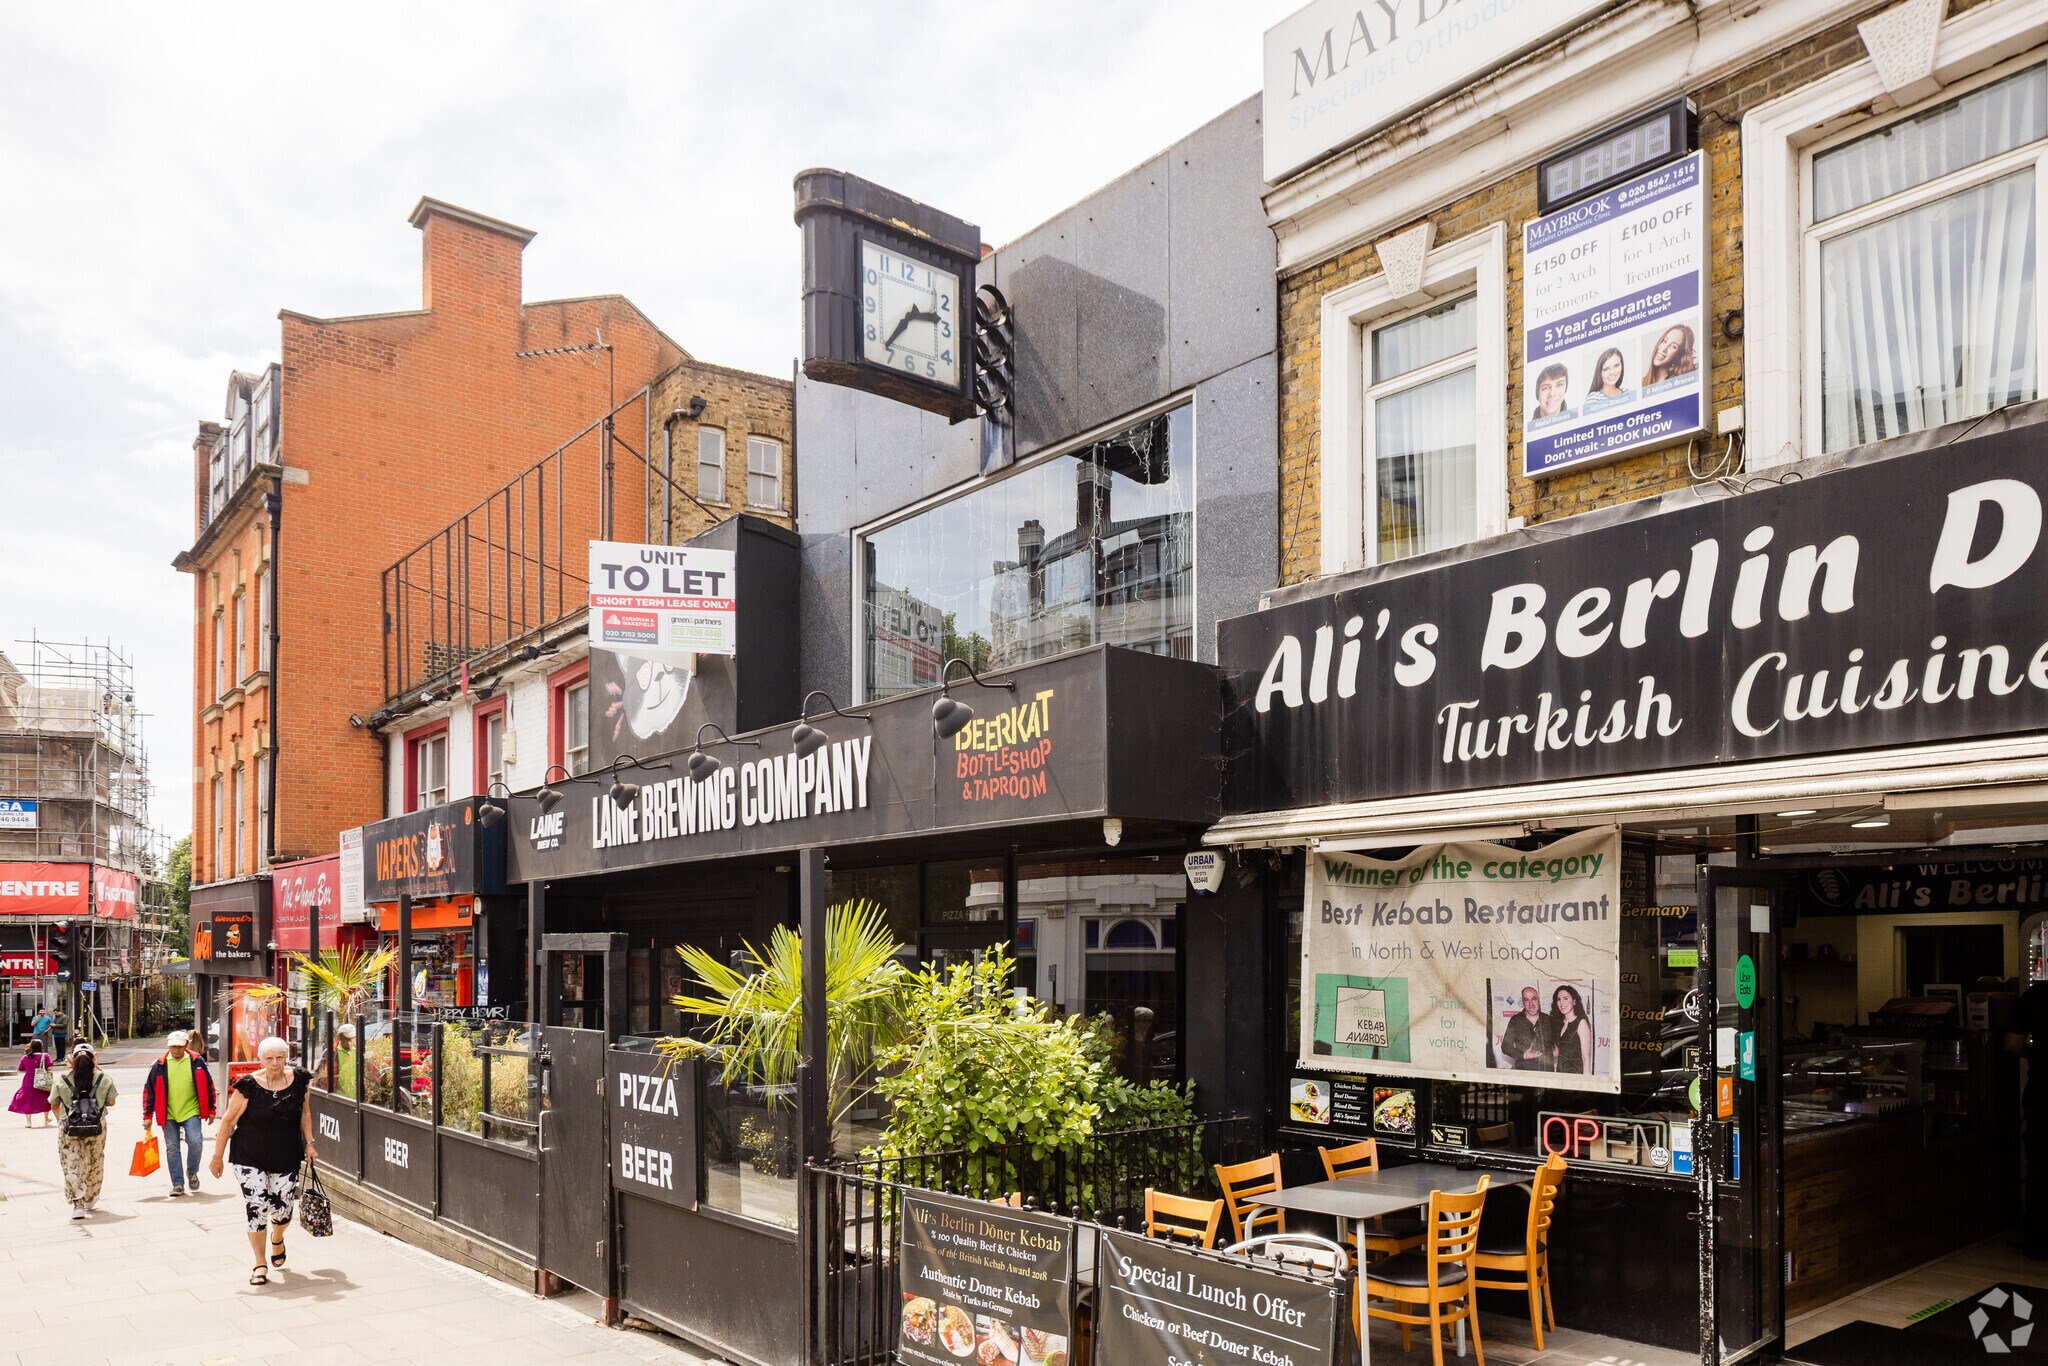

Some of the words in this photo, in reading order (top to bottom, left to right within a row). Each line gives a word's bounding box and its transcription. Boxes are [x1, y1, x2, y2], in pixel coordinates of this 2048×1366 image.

[1619, 176, 1694, 210] maybrookclinics.com
[1628, 183, 1645, 198] 020
[1647, 174, 1670, 191] 8567
[1673, 163, 1696, 181] 1515
[1529, 196, 1612, 242] MAYBROOK
[1529, 233, 1557, 249] Specialist
[1557, 218, 1593, 237] Orthodontic
[1594, 211, 1612, 222] Clinic
[1621, 216, 1657, 241] £100
[1662, 202, 1693, 224] OFF
[1534, 254, 1566, 275] £150
[1570, 240, 1598, 261] OFF
[1623, 248, 1642, 264] for
[1658, 229, 1691, 251] Arch
[901, 261, 914, 282] 12
[1536, 281, 1553, 297] for
[1566, 265, 1596, 287] Arch
[1623, 254, 1692, 286] Treatment
[865, 296, 876, 314] 9
[941, 294, 950, 312] 2
[1533, 289, 1599, 319] Treatments
[1544, 330, 1552, 343] 5
[1554, 316, 1588, 340] Year
[1590, 289, 1672, 327] Guarantee
[866, 324, 877, 341] 8
[941, 321, 951, 338] 3
[1544, 343, 1553, 352] on
[1554, 339, 1563, 349] all
[1564, 331, 1587, 346] dental
[1588, 326, 1602, 339] and
[1603, 310, 1647, 334] orthodontic
[885, 348, 895, 364] 7
[904, 355, 915, 372] 6
[926, 362, 936, 378] 5
[940, 350, 952, 366] 4
[1652, 381, 1673, 395] Month
[1674, 375, 1695, 387] Braces
[1553, 428, 1595, 449] Limited
[1597, 421, 1624, 438] Time
[1626, 410, 1662, 431] Offers
[1575, 440, 1599, 457] wait
[1607, 430, 1640, 448] BOOK
[1642, 419, 1673, 439] NOW
[640, 550, 687, 566] UNIT
[601, 563, 650, 592] TO
[662, 568, 726, 597] LET
[596, 596, 633, 606] SHORT
[634, 598, 665, 607] TERM
[667, 599, 701, 608] LEASE
[702, 600, 730, 609] ONLY
[1254, 607, 1439, 714] Ali's
[1481, 525, 1860, 673] Berlin
[1930, 479, 2044, 593] D
[1437, 675, 1683, 764] Turkish
[1730, 633, 2048, 739] Cuisine
[955, 689, 1054, 752] BEERKAT
[956, 738, 1052, 779] BOTTLESHOP
[592, 795, 640, 850] LAINE
[641, 766, 736, 842] BREWING
[740, 736, 872, 828] COMPANY
[962, 781, 972, 800] &
[973, 771, 1047, 801] TAPROOM
[529, 811, 565, 841] LAINE
[537, 840, 551, 851] BREW
[1188, 855, 1214, 866] URBAN
[1324, 859, 1405, 886] Winner
[1409, 857, 1430, 882] of
[1432, 854, 1473, 880] the
[1483, 852, 1604, 884] category
[280, 877, 293, 909] The
[317, 872, 332, 906] Box
[1854, 880, 1931, 910] Ali's
[1948, 874, 2048, 906] Berli
[942, 910, 964, 921] PIZZA
[1321, 899, 1364, 926] Best
[1372, 898, 1453, 927] Kebab
[1464, 893, 1610, 925] Restaurant
[1620, 902, 1690, 919] Germany
[215, 950, 228, 958] the
[227, 950, 252, 958] bakers
[1351, 941, 1362, 959] in
[1368, 941, 1412, 960] North
[1420, 940, 1435, 960] &
[1441, 940, 1483, 960] West
[1490, 941, 1561, 961] London
[1740, 971, 1752, 983] Uber
[1740, 984, 1752, 995] Eats
[1353, 1005, 1384, 1018] BRITISH
[1357, 1019, 1385, 1032] KEBAB
[1440, 1016, 1456, 1029] for
[1620, 1004, 1666, 1022] Bread
[1346, 1031, 1387, 1045] AWARDS
[1428, 1036, 1468, 1052] voting!
[619, 1072, 679, 1117] PIZZA
[319, 1112, 341, 1143] PIZZA
[1543, 1116, 1664, 1164] OPEN
[384, 1136, 410, 1169] BEER
[621, 1142, 674, 1191] BEER
[913, 1207, 937, 1226] Ali's
[940, 1212, 976, 1235] Berlin
[1019, 1228, 1063, 1253] Kebab
[931, 1229, 937, 1239] %
[938, 1233, 951, 1243] 100
[952, 1234, 979, 1251] Quality
[980, 1239, 997, 1255] Beef
[997, 1244, 1005, 1255] &
[1006, 1246, 1037, 1262] Chicken
[938, 1246, 947, 1258] of
[959, 1250, 983, 1266] British
[983, 1256, 1006, 1272] Kebab
[1006, 1261, 1031, 1278] Award
[1031, 1271, 1048, 1282] 2018
[920, 1264, 967, 1290] Authentic
[968, 1276, 1003, 1300] Doner
[1004, 1285, 1041, 1309] Kebab
[942, 1287, 956, 1301] Made
[962, 1293, 981, 1307] Turks
[981, 1298, 988, 1308] in
[988, 1300, 1014, 1318] Germany
[1118, 1256, 1182, 1293] Special
[1187, 1273, 1248, 1312] Lunch
[1252, 1292, 1306, 1328] Offer
[1122, 1303, 1165, 1331] Chicken
[1168, 1321, 1181, 1335] or
[1182, 1322, 1210, 1346] Beef
[1209, 1333, 1250, 1358] Doner
[1252, 1344, 1294, 1366] Kebab
[1197, 1350, 1205, 1360] +
